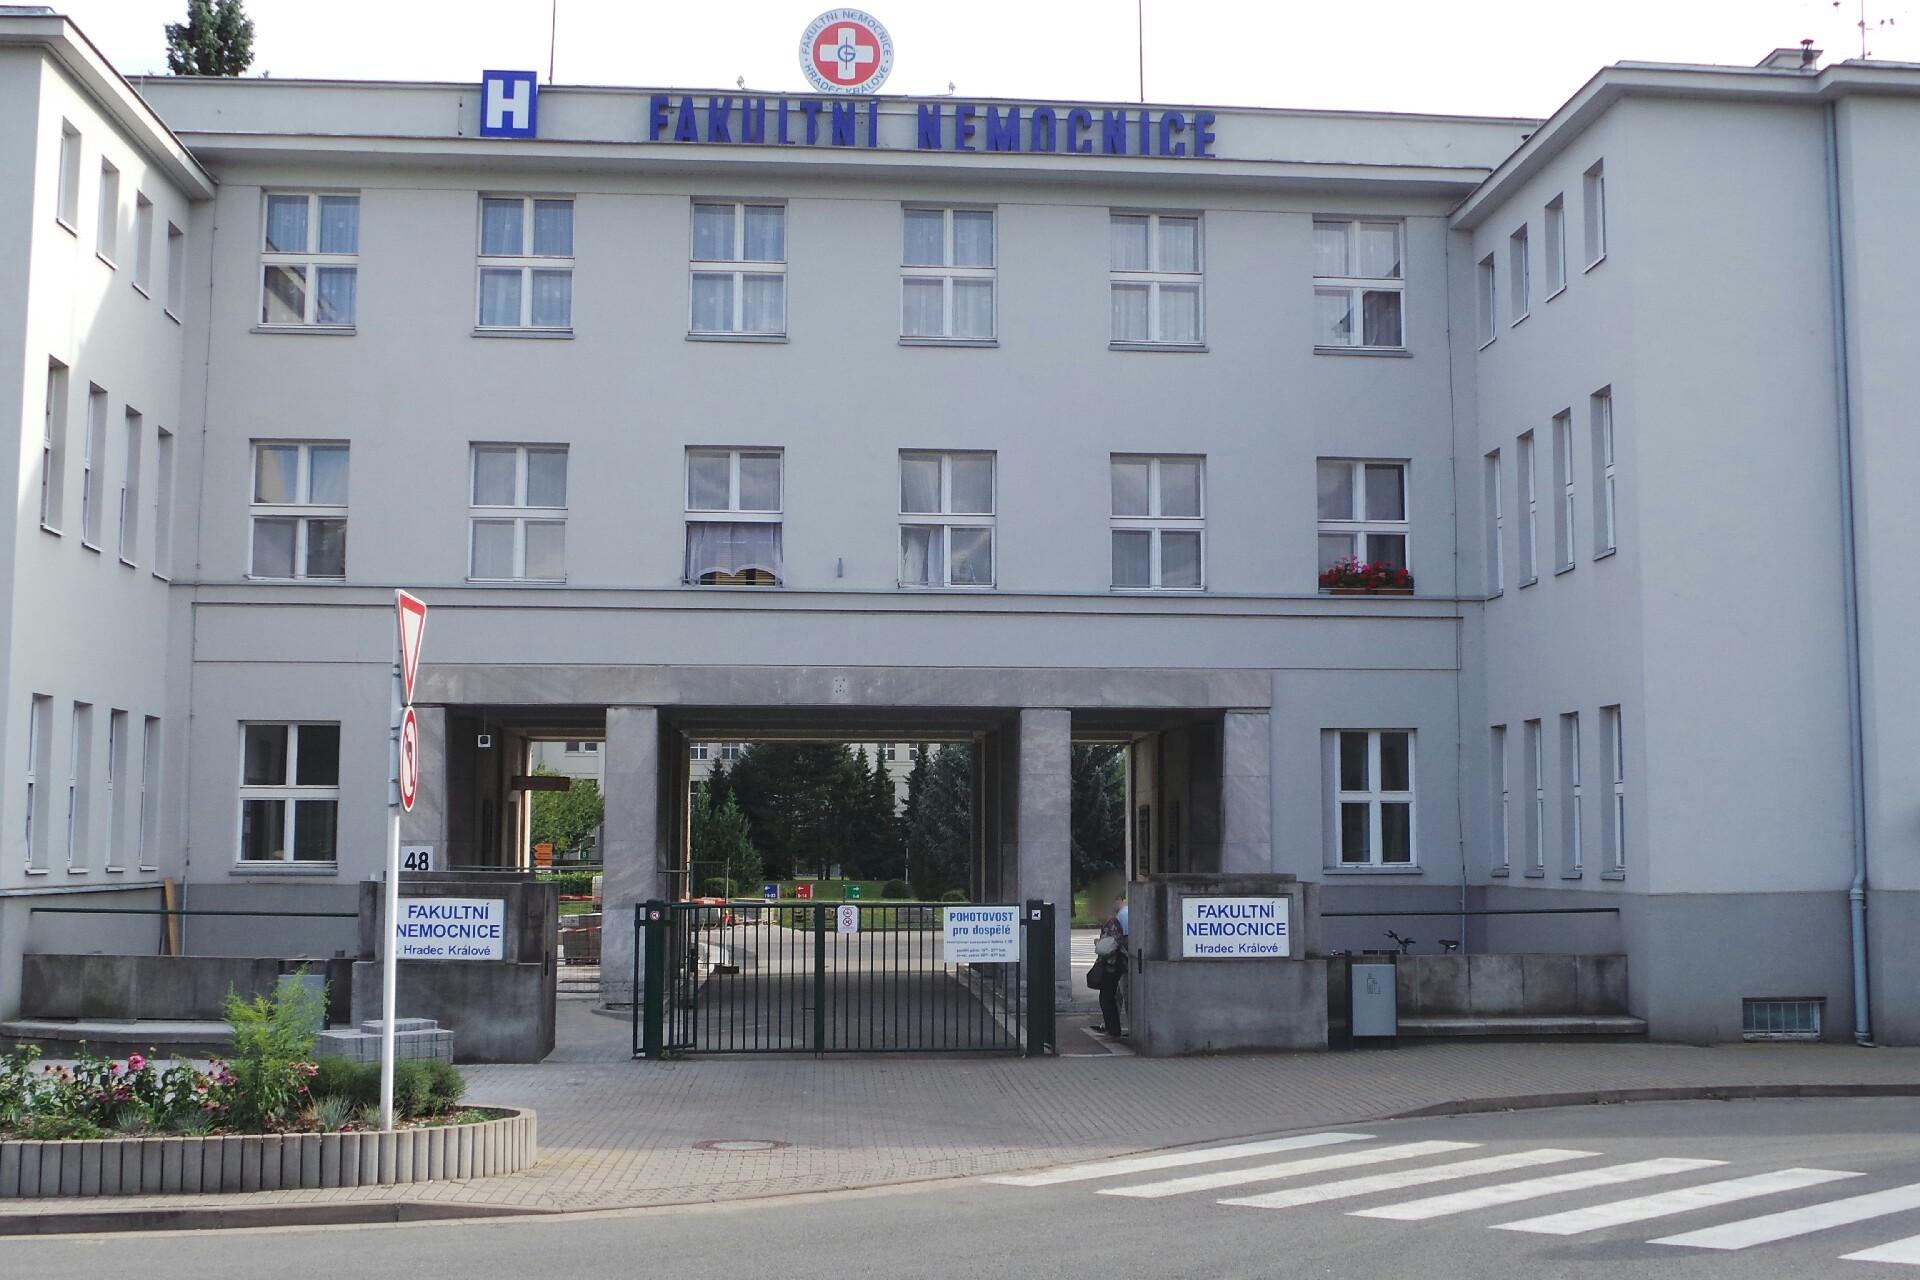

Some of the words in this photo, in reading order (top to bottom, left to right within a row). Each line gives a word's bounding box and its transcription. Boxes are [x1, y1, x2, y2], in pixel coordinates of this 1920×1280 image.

[842, 10, 892, 56] NEMOCNICE
[486, 79, 530, 129] H
[917, 103, 1216, 158] NEMOCNICE
[404, 852, 429, 871] 48
[408, 902, 491, 919] FAKULTNÍ
[949, 912, 1014, 922] POHOTOVOST
[1197, 901, 1275, 918] FAKULTNÍ
[396, 924, 500, 938] NEMOCNICE
[952, 927, 968, 936] pro
[973, 924, 1011, 936] dospělé
[1186, 923, 1287, 936] NEMOCNICE
[404, 945, 443, 955] Hradec
[448, 945, 491, 955] Králové
[1195, 943, 1234, 953] Hradec
[1238, 942, 1279, 953] Králové
